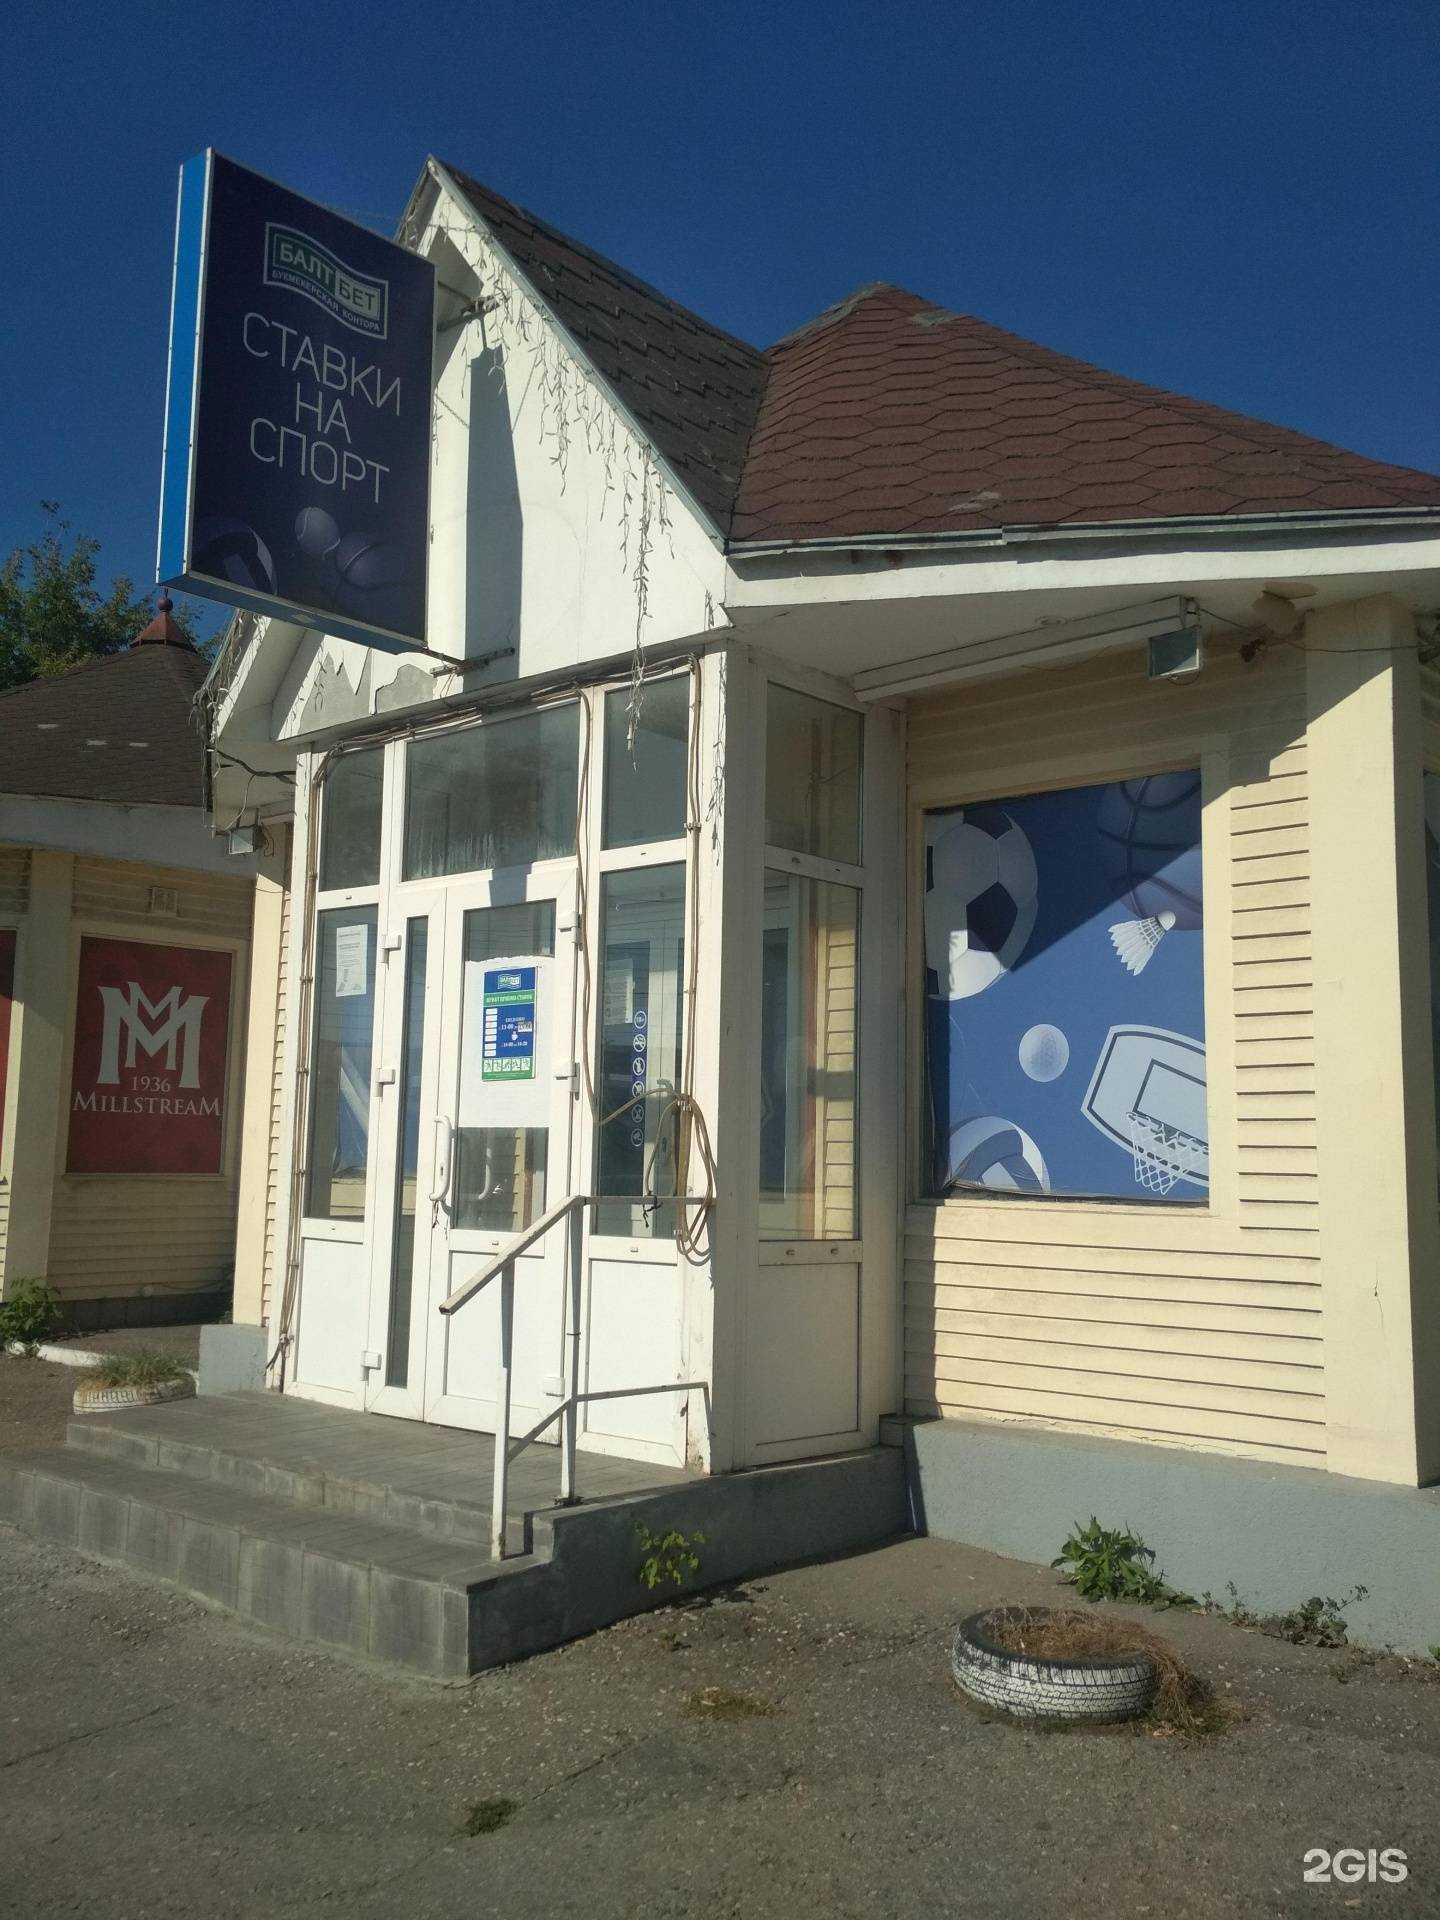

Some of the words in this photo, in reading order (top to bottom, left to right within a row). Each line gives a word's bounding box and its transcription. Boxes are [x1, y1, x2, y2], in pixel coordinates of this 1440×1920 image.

[342, 310, 380, 332] КОНТОРА
[242, 312, 401, 417] СТАВКИ
[295, 381, 352, 444] НА
[250, 417, 390, 504] СПОРТ
[71, 1090, 222, 1116] MILLSTREAM
[130, 1075, 171, 1092] 1936
